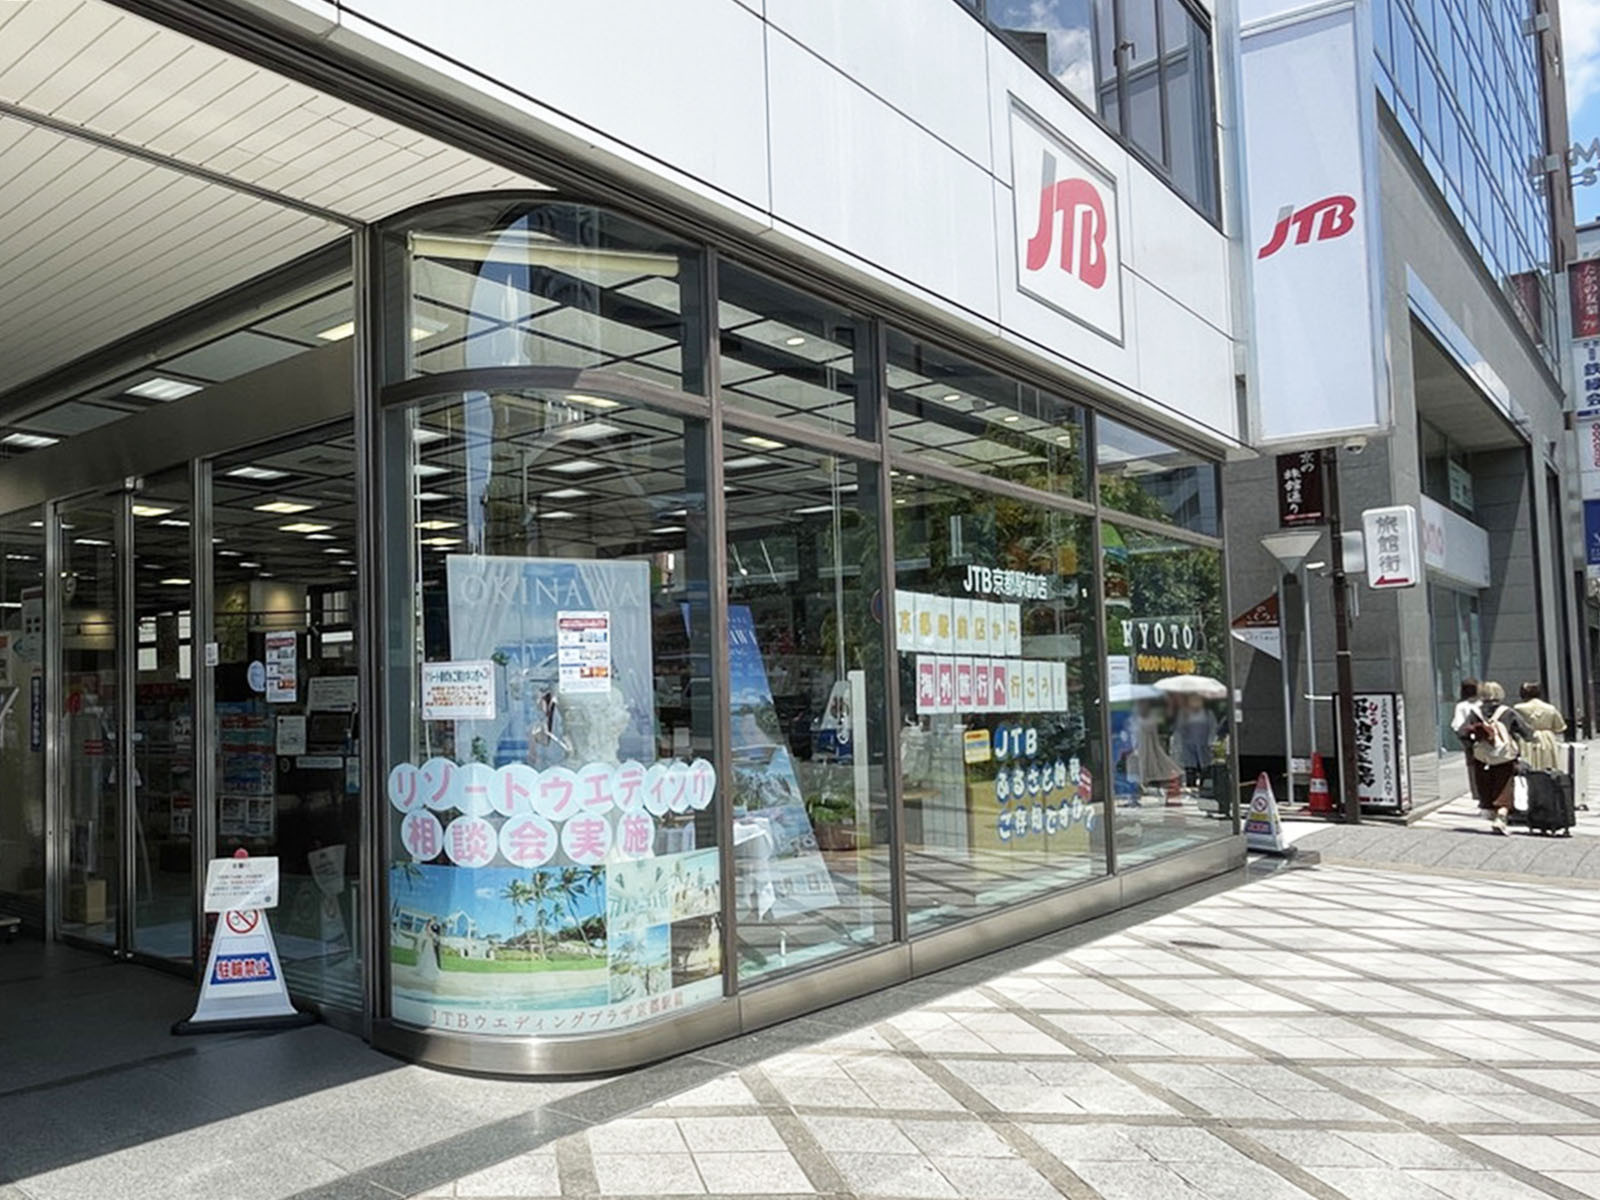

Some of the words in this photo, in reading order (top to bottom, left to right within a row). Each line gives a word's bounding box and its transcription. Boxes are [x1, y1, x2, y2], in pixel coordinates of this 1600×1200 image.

[1026, 149, 1108, 289] JTB
[1257, 195, 1357, 260] JTB
[1375, 514, 1401, 573] 旅館街
[460, 576, 640, 607] OKINAWA
[1121, 620, 1193, 649] KYOTO
[994, 727, 1037, 758] JTB
[396, 763, 713, 813] リゾートウエディング
[407, 814, 652, 862] 相談会実施
